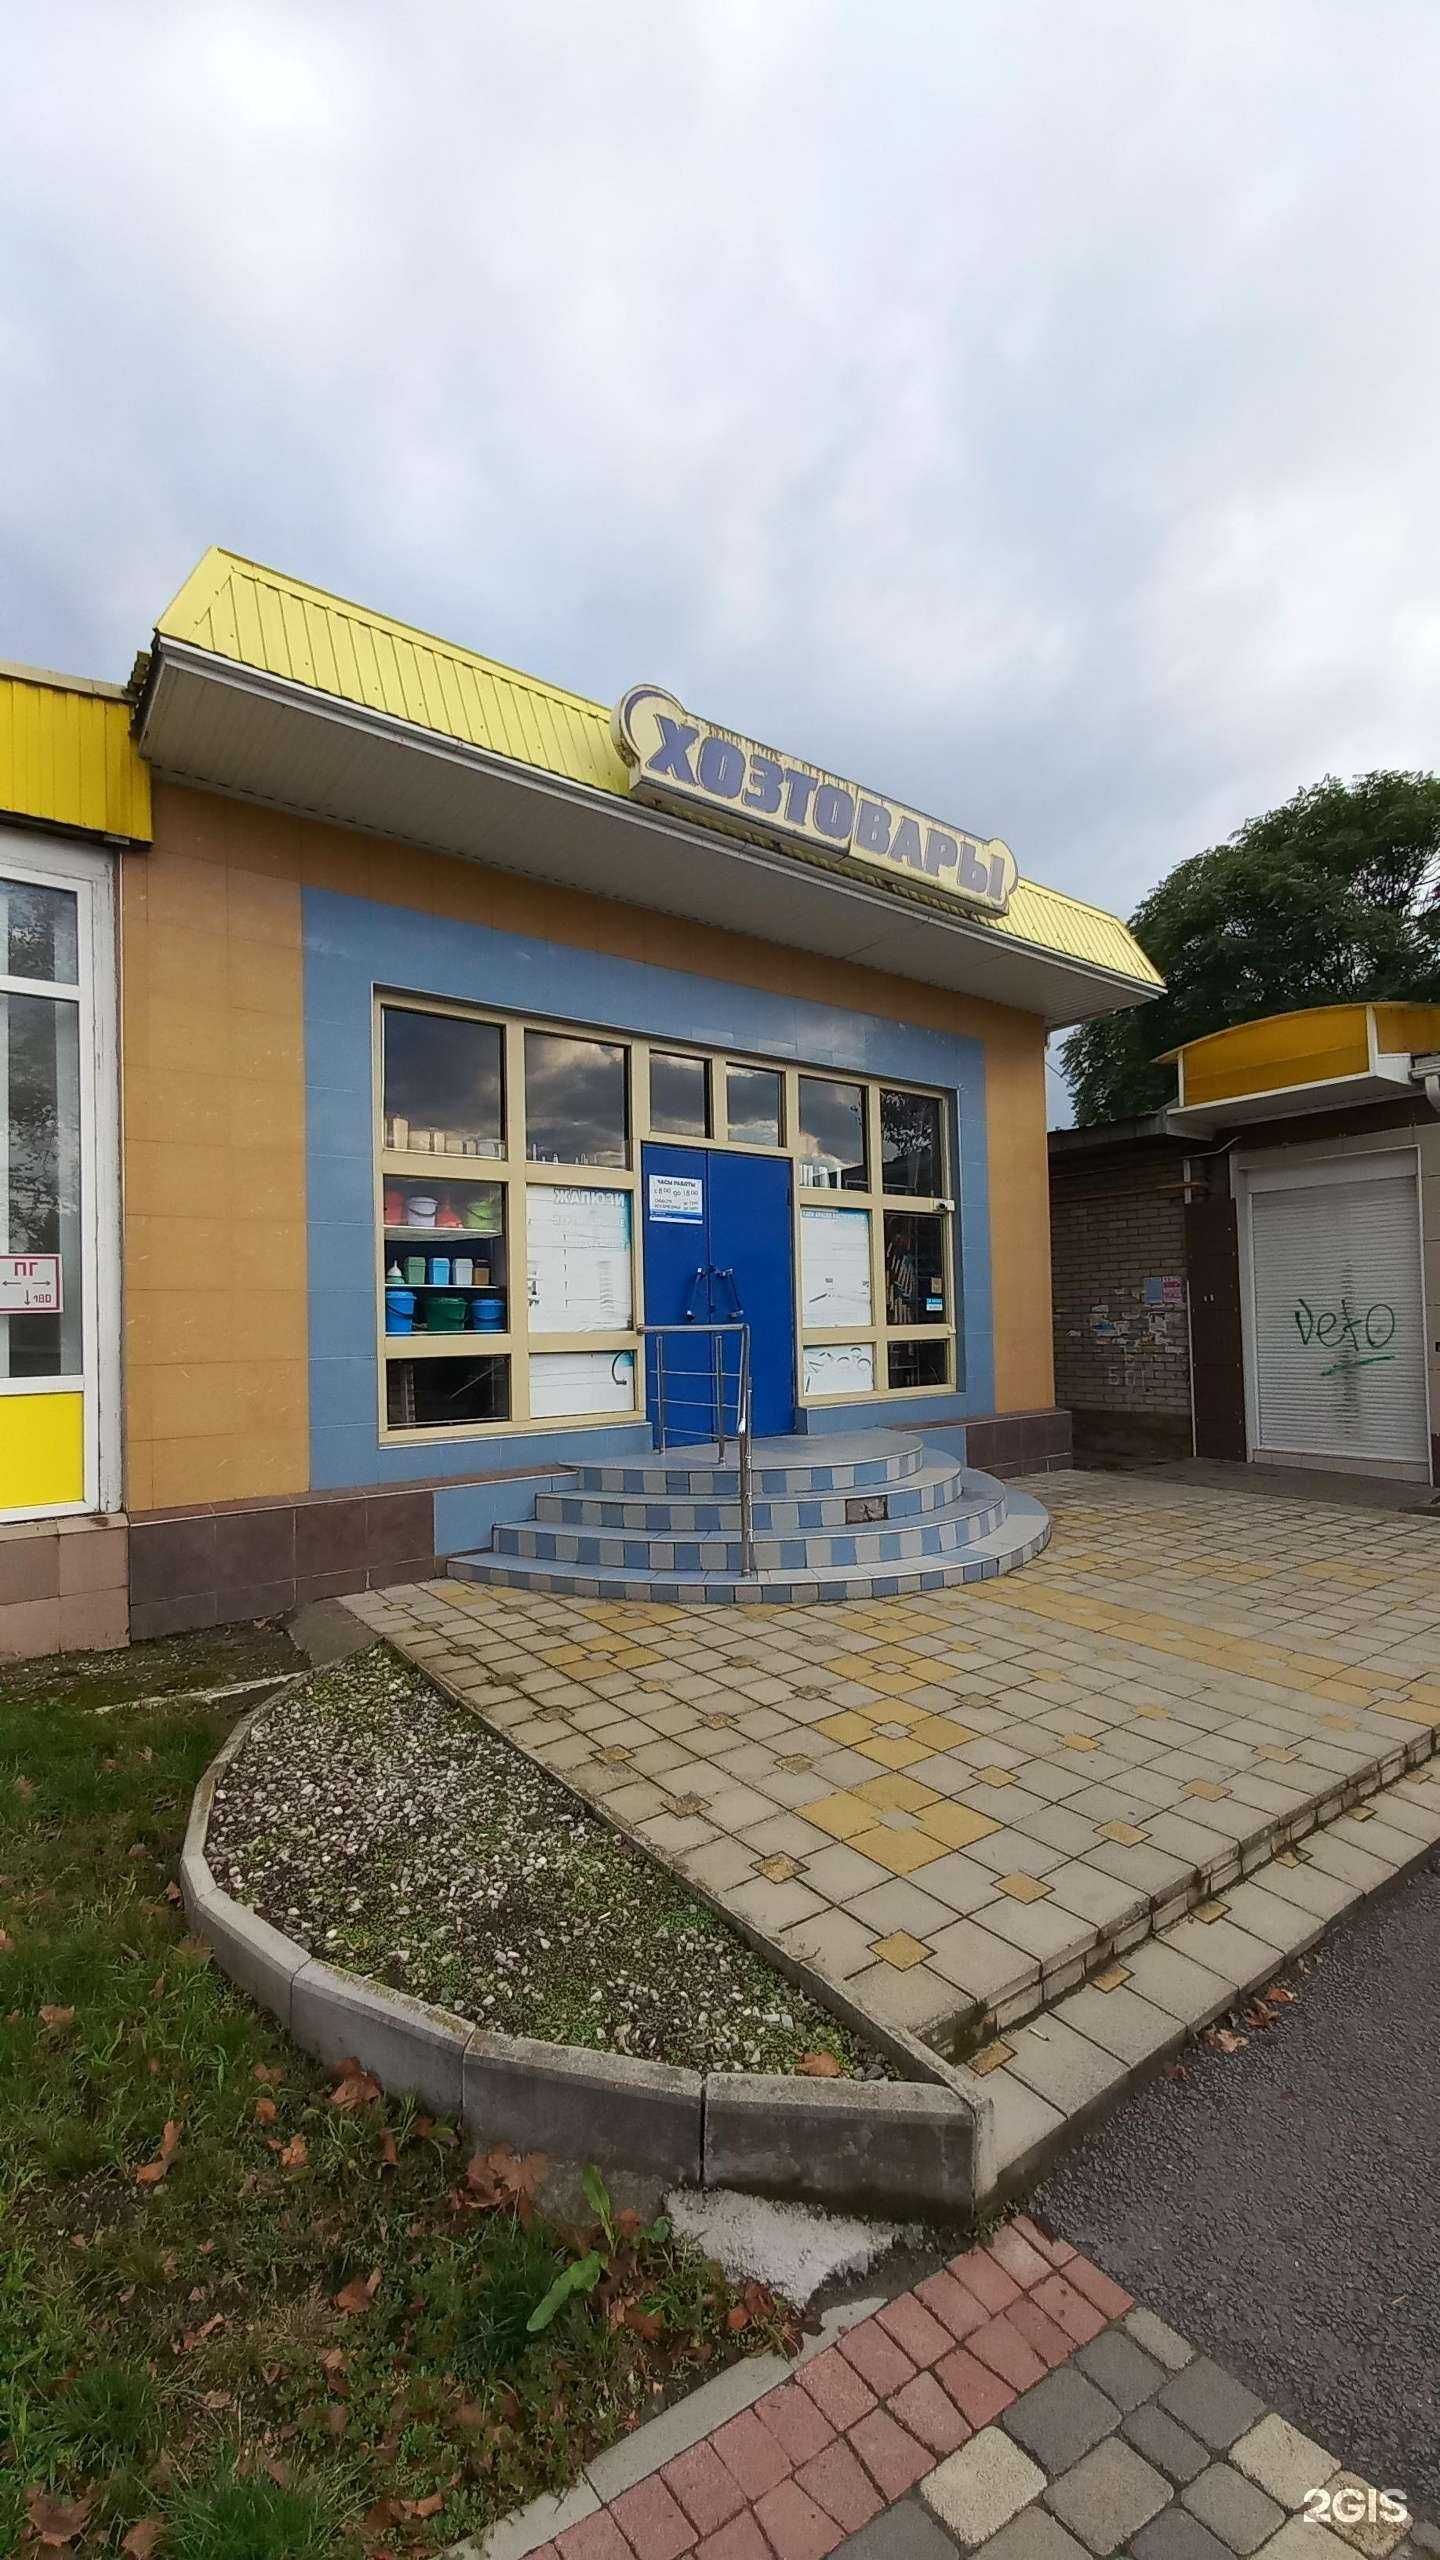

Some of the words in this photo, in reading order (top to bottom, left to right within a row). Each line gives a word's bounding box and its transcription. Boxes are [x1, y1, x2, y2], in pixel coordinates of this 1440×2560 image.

[646, 713, 1005, 898] ХОЗТОВАРЫ
[553, 1188, 626, 1208] ЖАЛЮЗИ
[14, 1261, 38, 1276] ПГ
